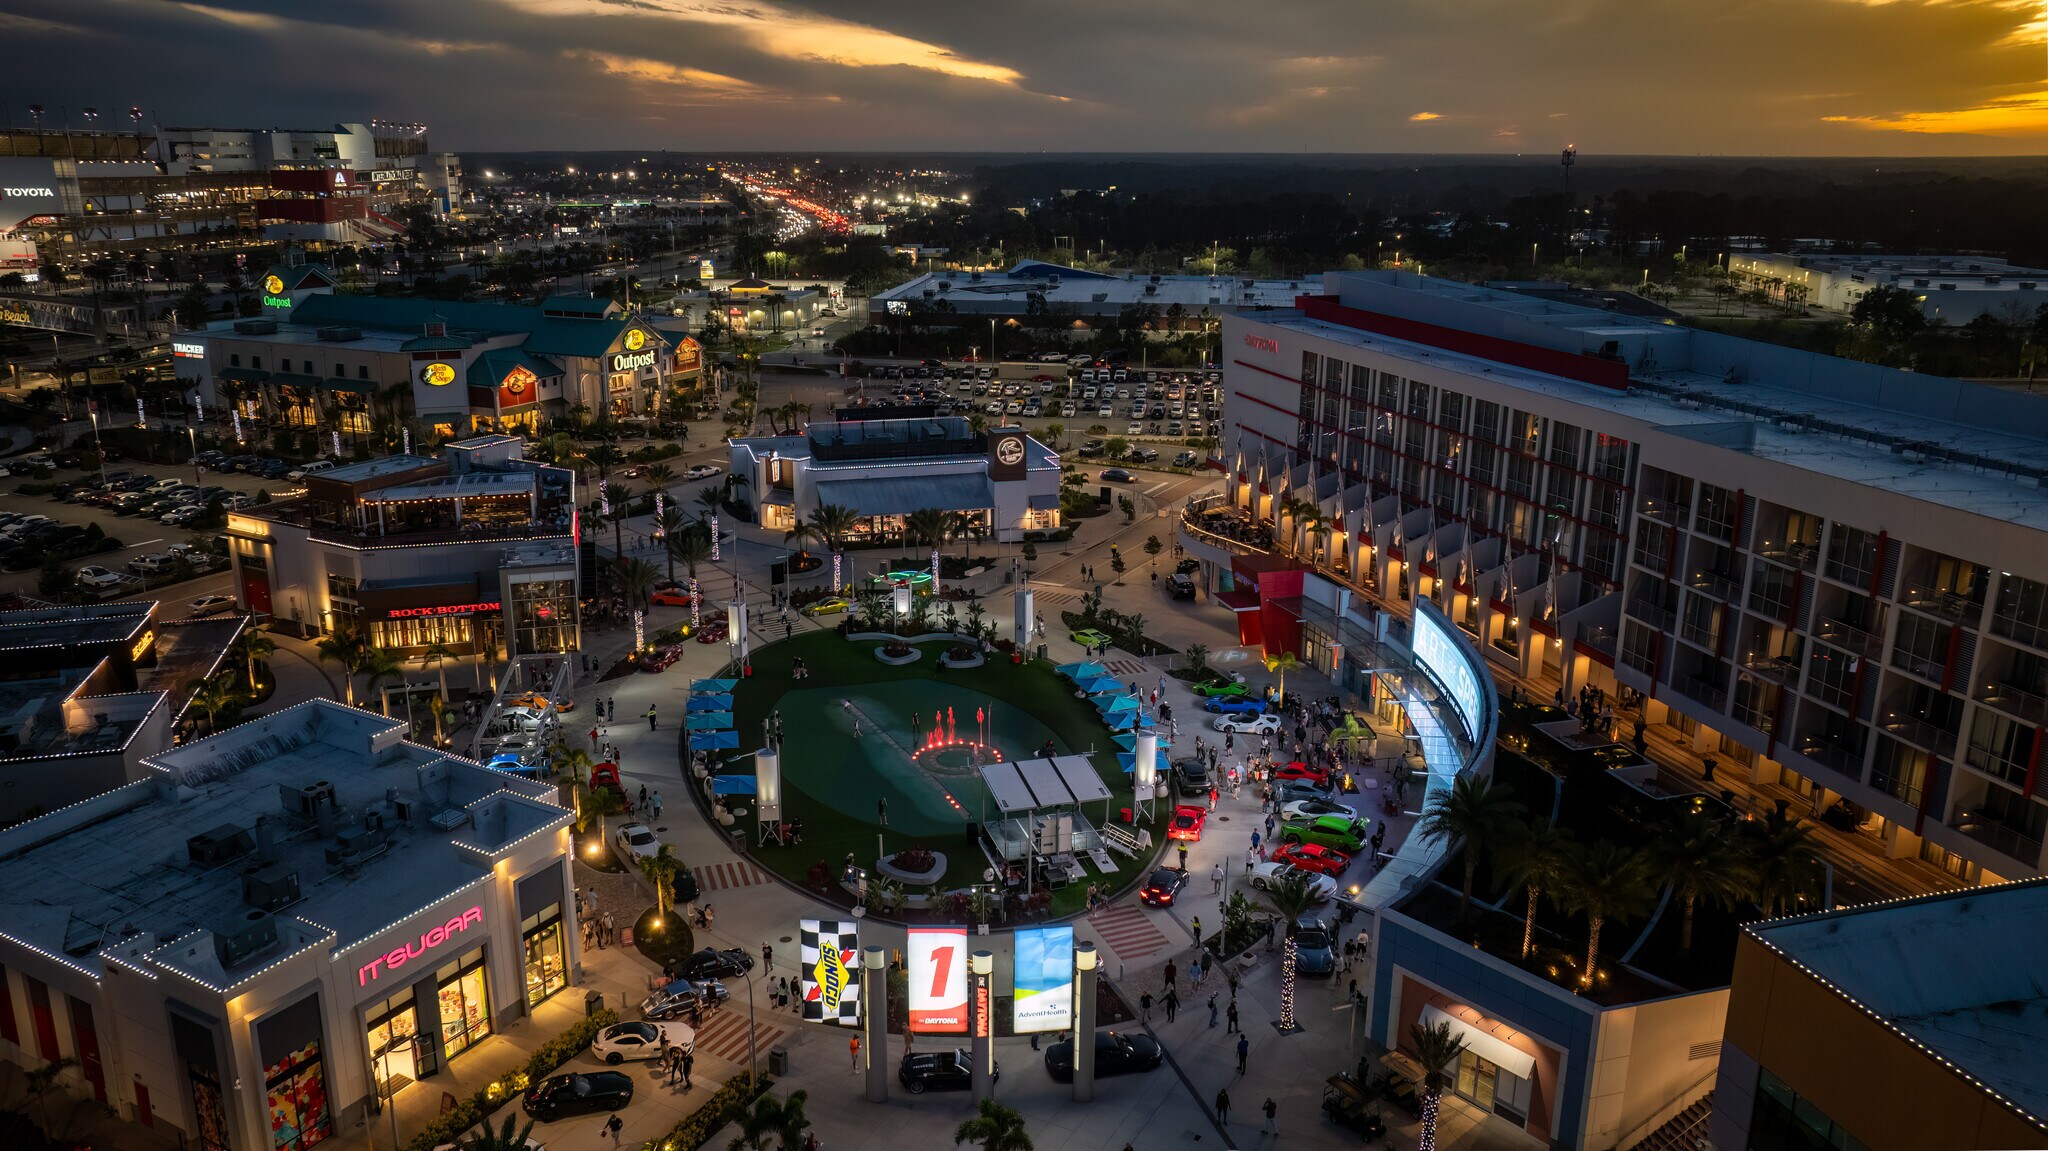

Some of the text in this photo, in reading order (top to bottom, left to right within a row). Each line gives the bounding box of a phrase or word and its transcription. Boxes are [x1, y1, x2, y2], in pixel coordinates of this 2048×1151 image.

[4, 188, 54, 197] TOYOTA
[263, 295, 291, 309] Outpost
[4, 309, 31, 323] Beach
[173, 343, 204, 354] TRACKER
[614, 350, 655, 371] Outpost
[389, 602, 501, 618] ROCK BOTTOM
[1416, 623, 1448, 668] ART
[358, 905, 483, 987] IT'SUGAR
[822, 944, 839, 1007] SUNOCO
[929, 946, 955, 998] 1
[976, 987, 988, 1038] DAYTONA
[1018, 1009, 1067, 1018] AdventHealth
